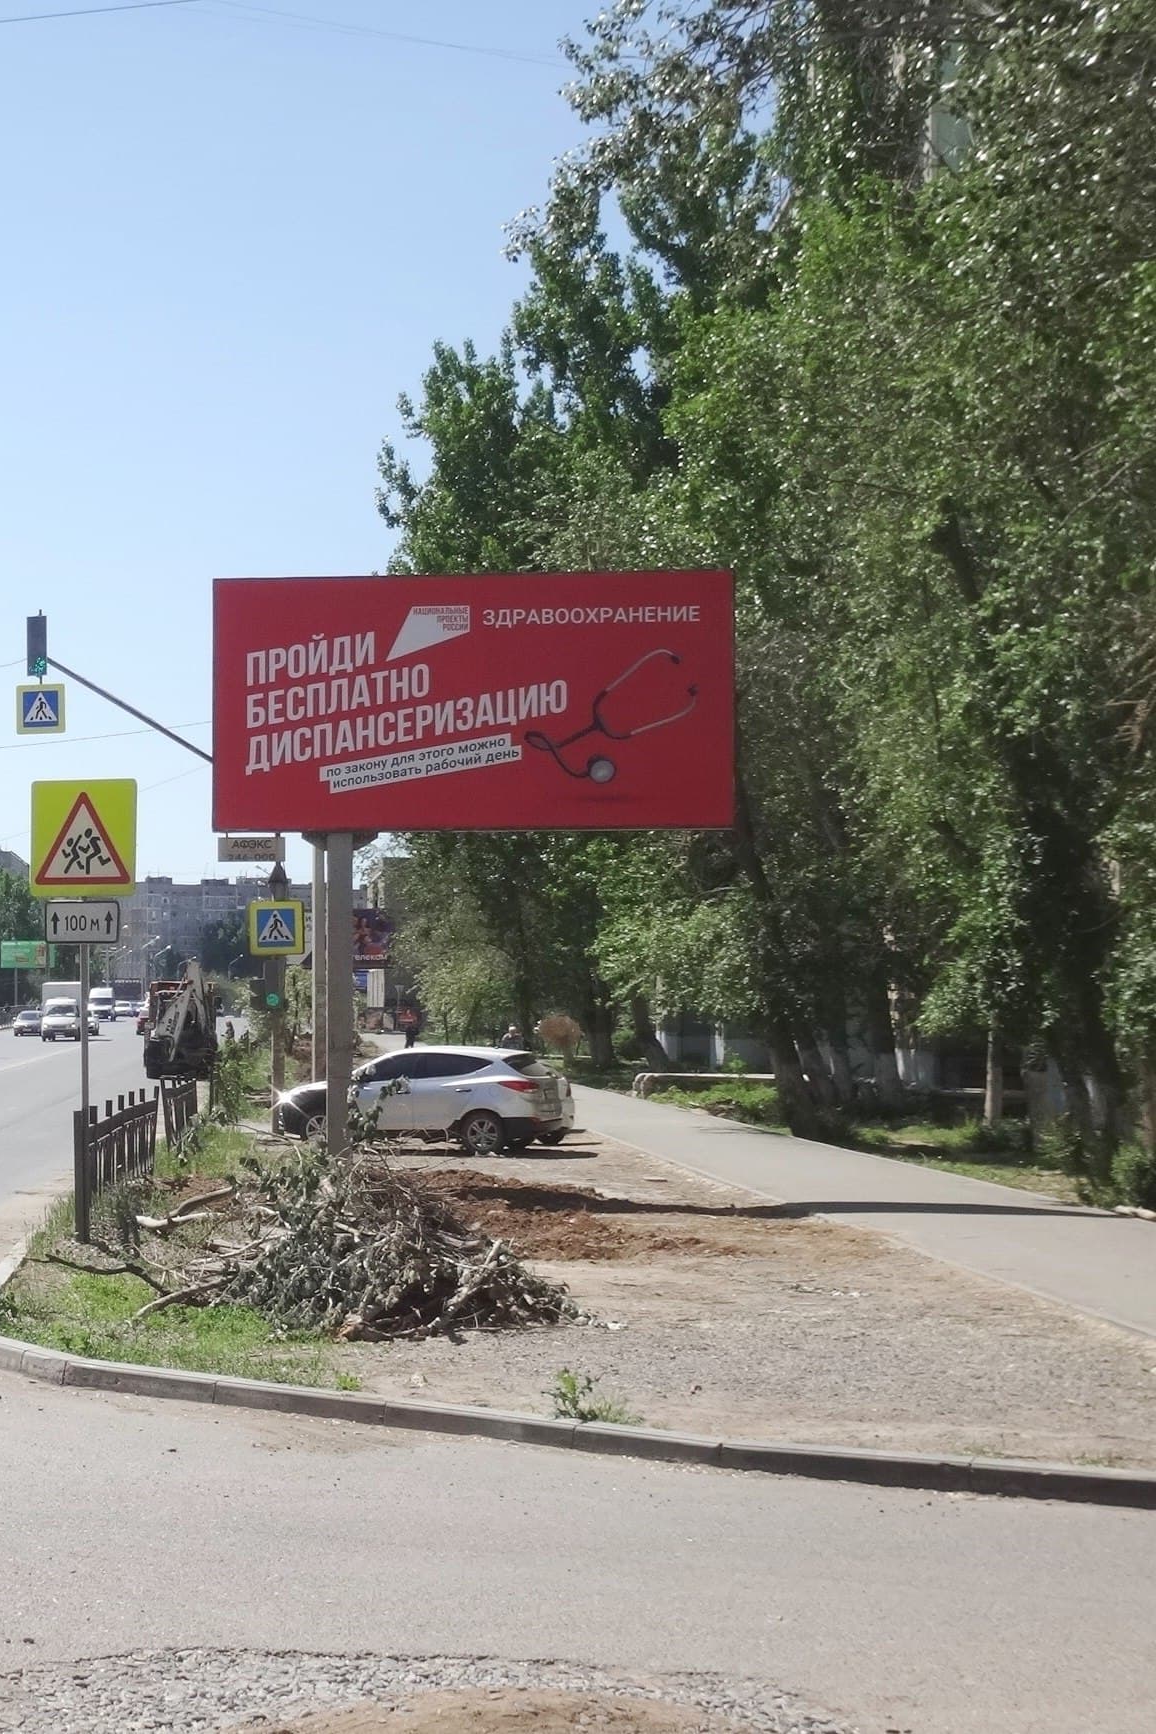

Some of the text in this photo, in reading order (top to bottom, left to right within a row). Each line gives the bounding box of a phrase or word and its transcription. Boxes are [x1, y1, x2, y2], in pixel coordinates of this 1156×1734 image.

[442, 623, 469, 632] РОССИИ
[482, 605, 701, 629] ЗДРАВООХРАНЕНИЕ
[246, 631, 375, 687] ПРОЙДИ
[246, 663, 430, 729] БЕСПЛАТНО
[245, 679, 568, 776] ДИСПАНСЕРИЗАЦИЮ
[326, 737, 506, 779] по закону для этого можно
[332, 748, 520, 789] использовать рабочий день
[231, 839, 273, 849] АФЭКС
[65, 915, 87, 931] 100
